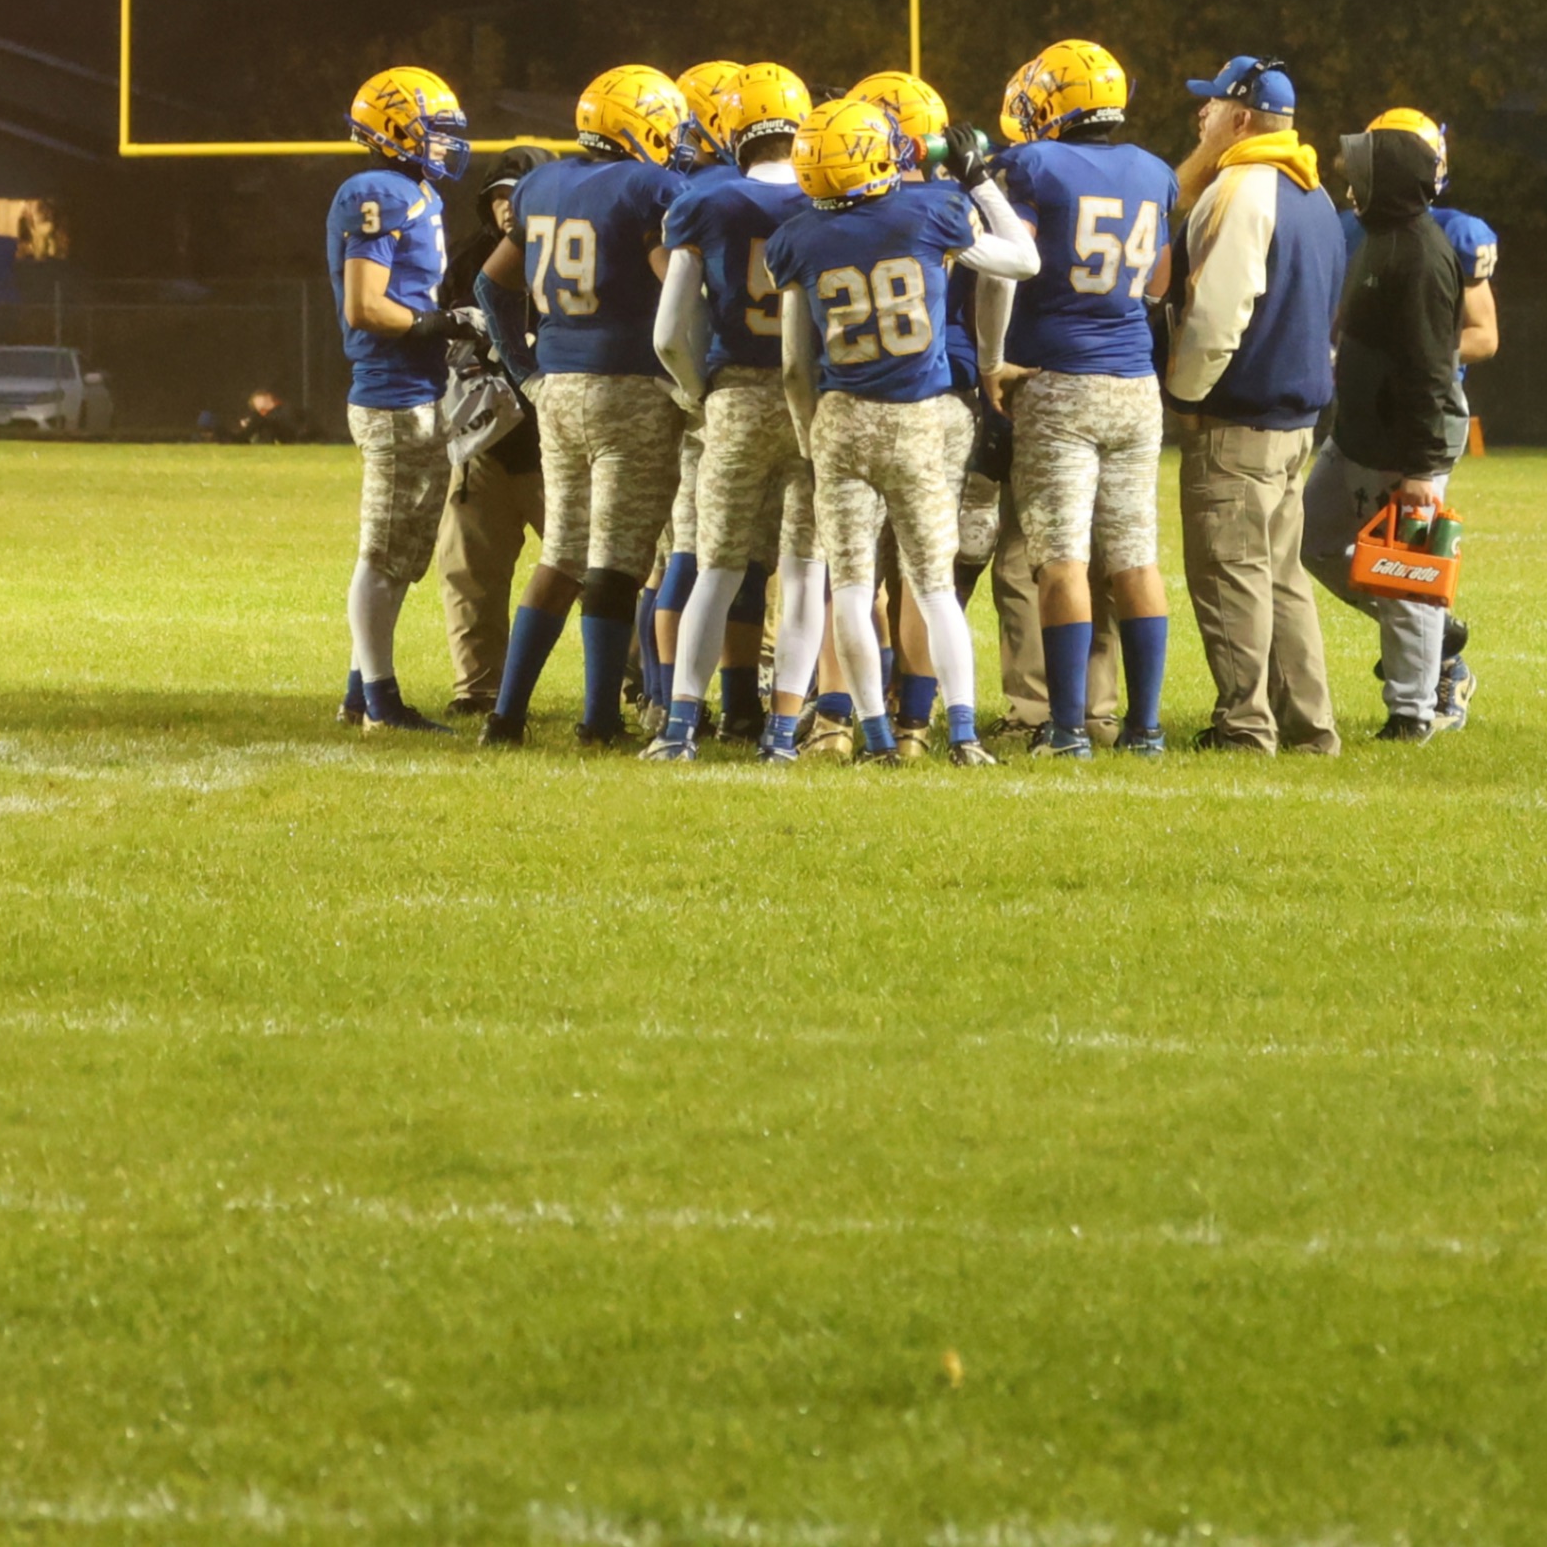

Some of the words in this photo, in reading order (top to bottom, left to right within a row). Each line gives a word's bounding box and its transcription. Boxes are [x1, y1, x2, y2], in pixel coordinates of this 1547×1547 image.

[361, 201, 381, 234] 3
[527, 215, 600, 315] 79
[1070, 196, 1158, 298] 54
[817, 256, 933, 365] 28
[1371, 558, 1440, 582] Gatorade
